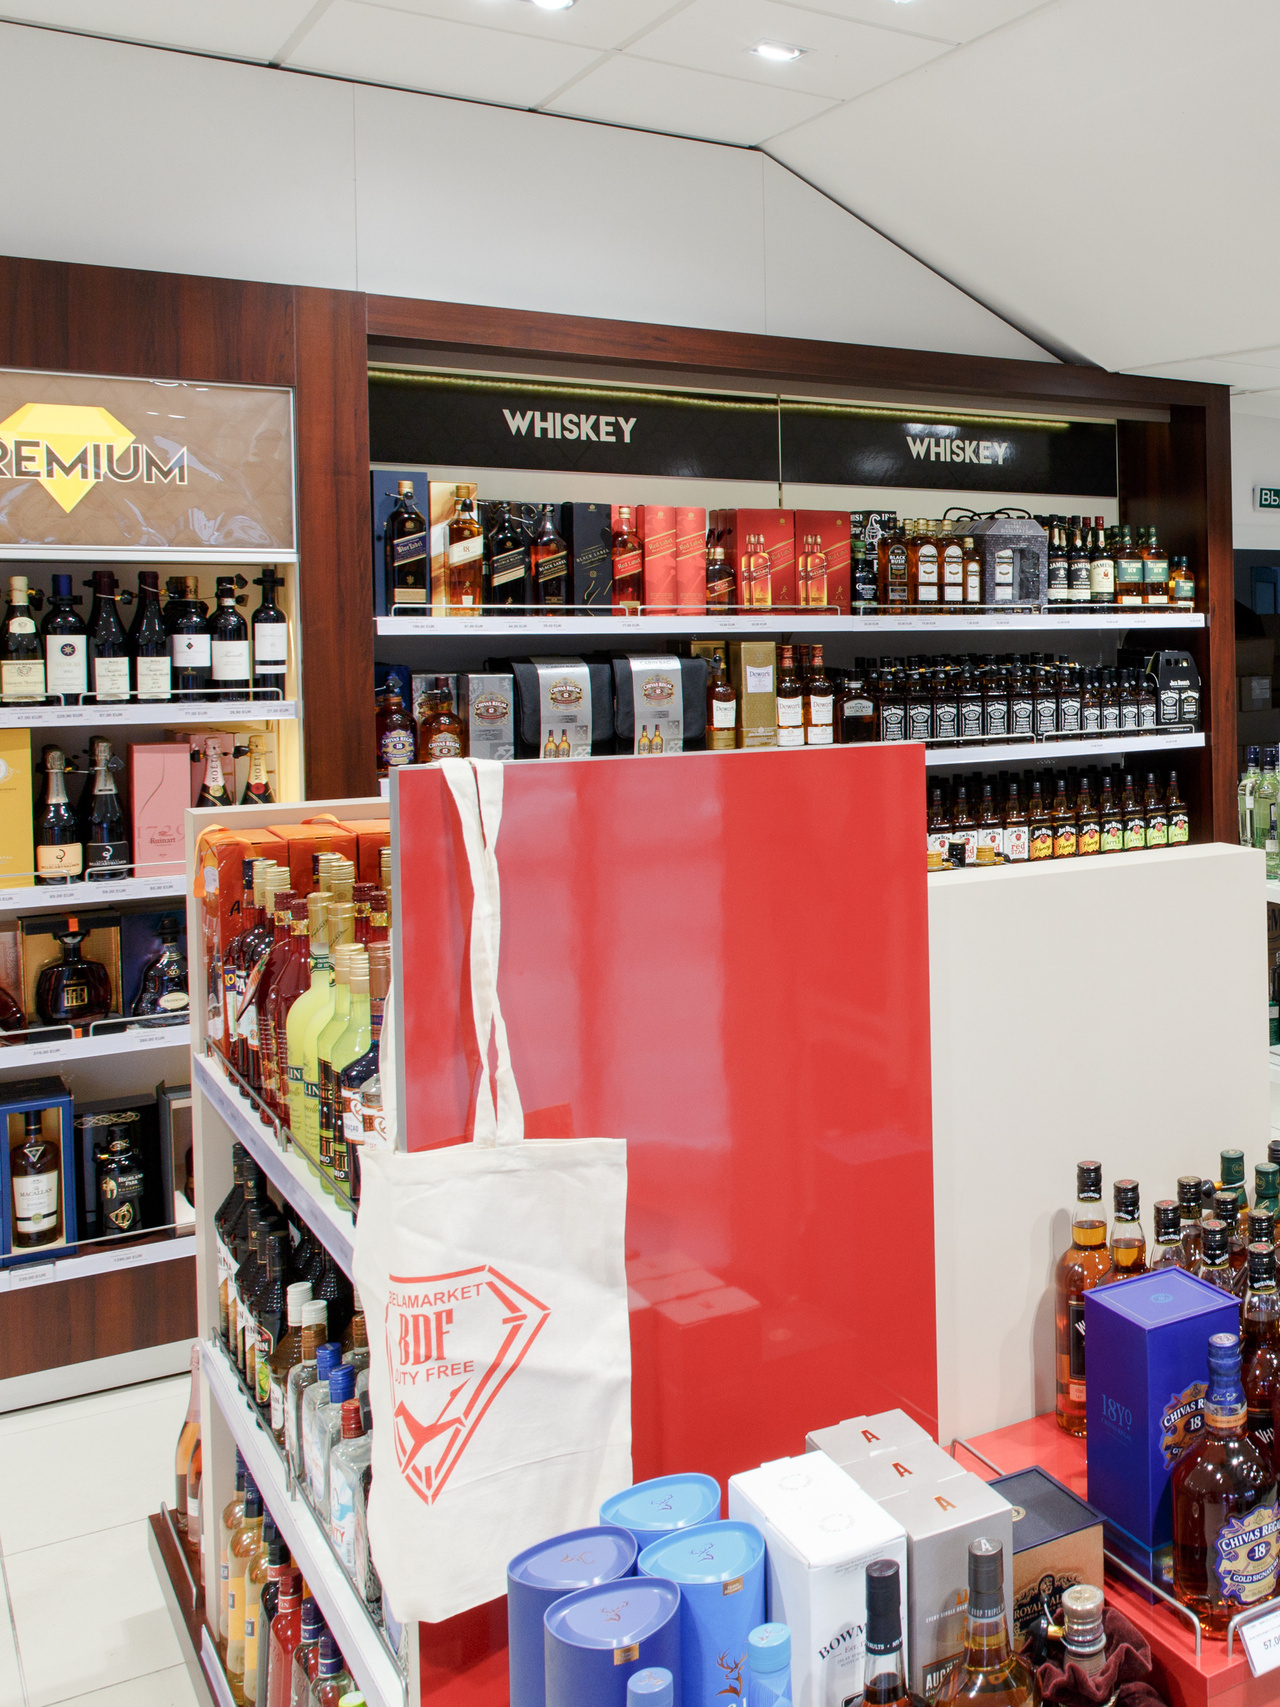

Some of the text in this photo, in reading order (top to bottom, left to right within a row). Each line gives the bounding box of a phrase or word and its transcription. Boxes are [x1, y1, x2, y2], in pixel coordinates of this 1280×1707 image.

[502, 408, 637, 443] WHISKEY
[906, 436, 1008, 465] WHISKEY
[550, 685, 582, 694] CHIVAS REGAL
[428, 742, 444, 750] CHIVAS
[149, 835, 176, 844] Ruinart
[1011, 842, 1025, 850] red
[118, 1172, 144, 1183] HIGHLAND
[124, 1179, 139, 1187] PARK
[19, 1187, 53, 1198] MACALLAN
[398, 1308, 454, 1366] BDF
[394, 1360, 475, 1386] DUTY FREE
[1163, 1401, 1196, 1427] CHIVAS
[1189, 1415, 1202, 1430] 18
[860, 1429, 880, 1443] A
[892, 1461, 913, 1478] A
[934, 1495, 956, 1512] A
[979, 1538, 993, 1551] A
[1221, 1528, 1260, 1552] CHIVAS
[1253, 1543, 1266, 1560] 18
[1232, 1571, 1253, 1583] GOLD
[1014, 1601, 1044, 1620] ROYAL
